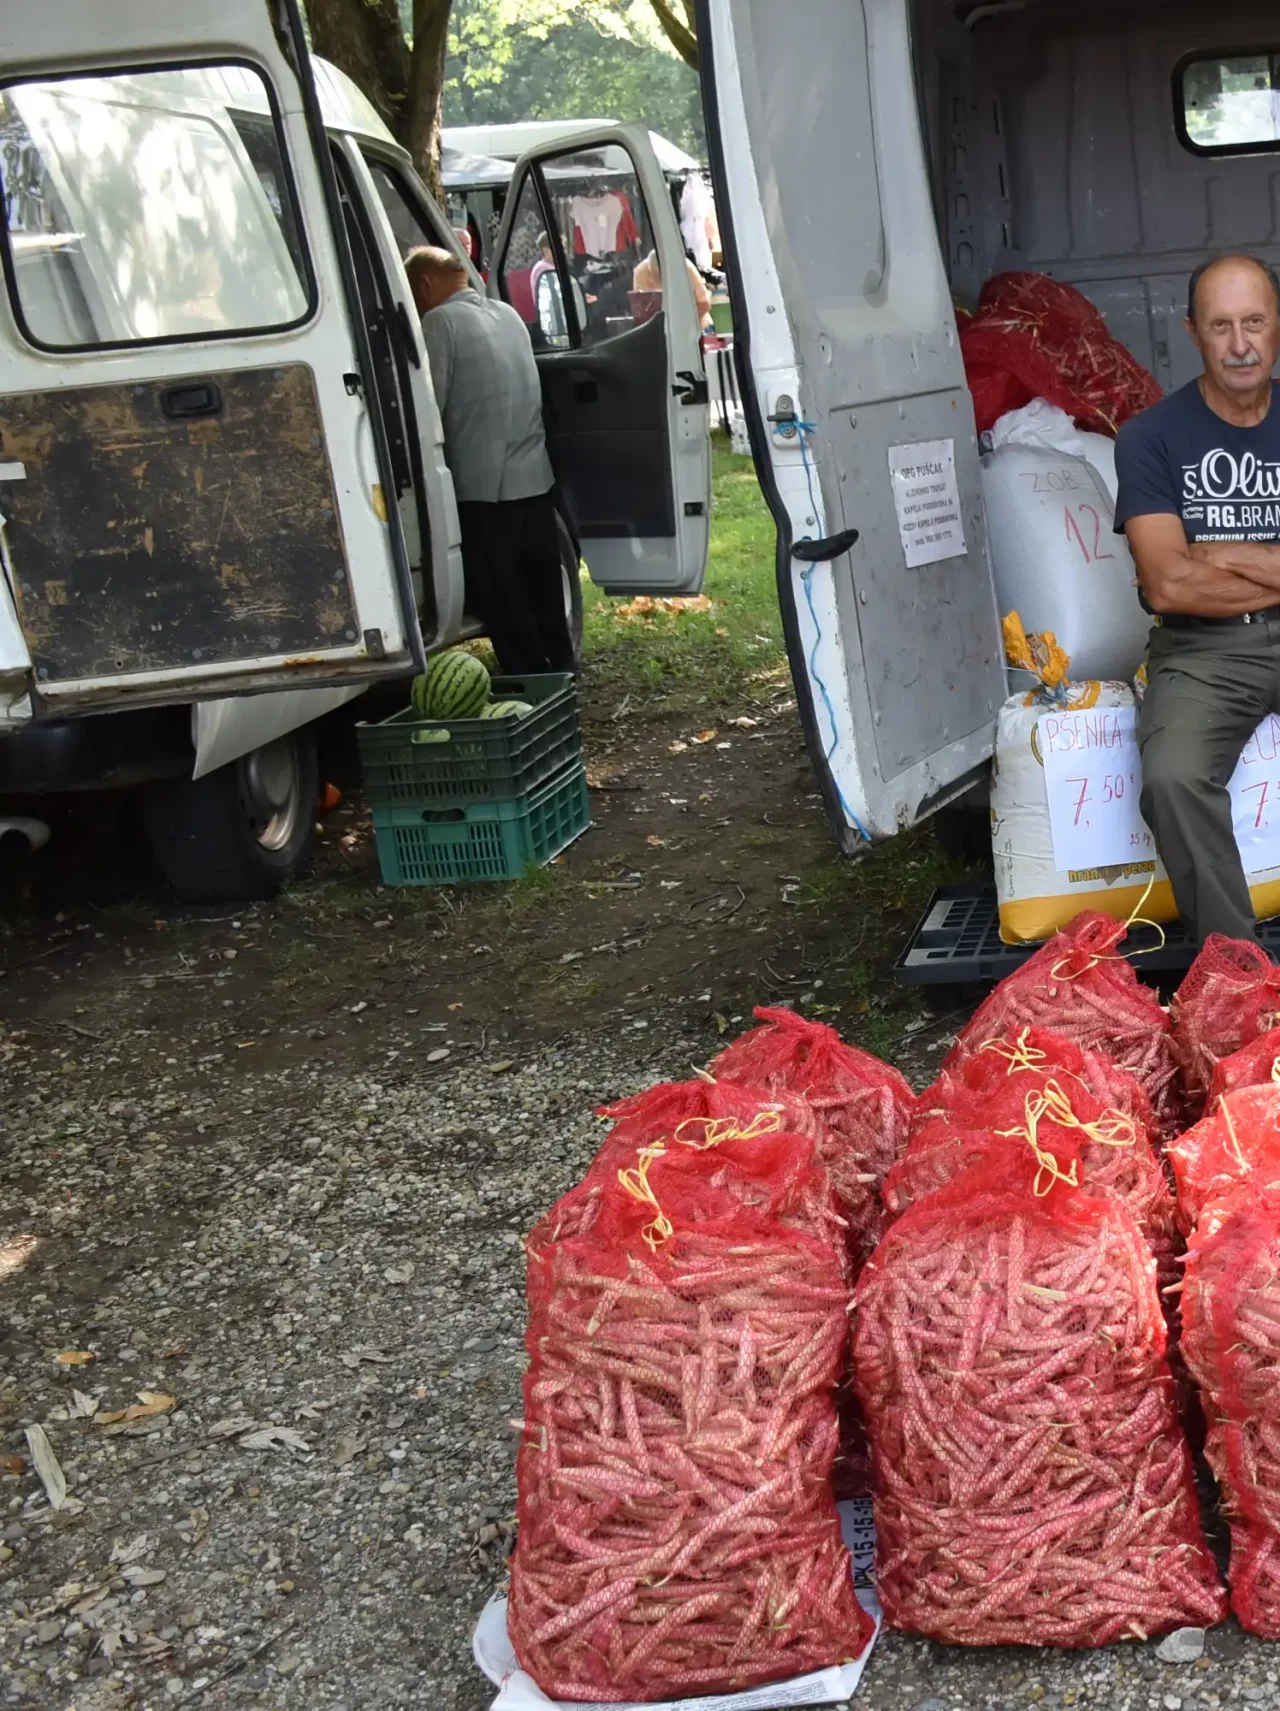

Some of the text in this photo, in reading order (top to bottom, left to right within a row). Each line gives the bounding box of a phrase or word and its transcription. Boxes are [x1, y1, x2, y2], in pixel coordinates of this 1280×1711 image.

[1019, 469, 1079, 493] ZOB
[1065, 504, 1113, 564] 12
[1130, 833, 1140, 845] 25
[1068, 864, 1102, 883] hran
